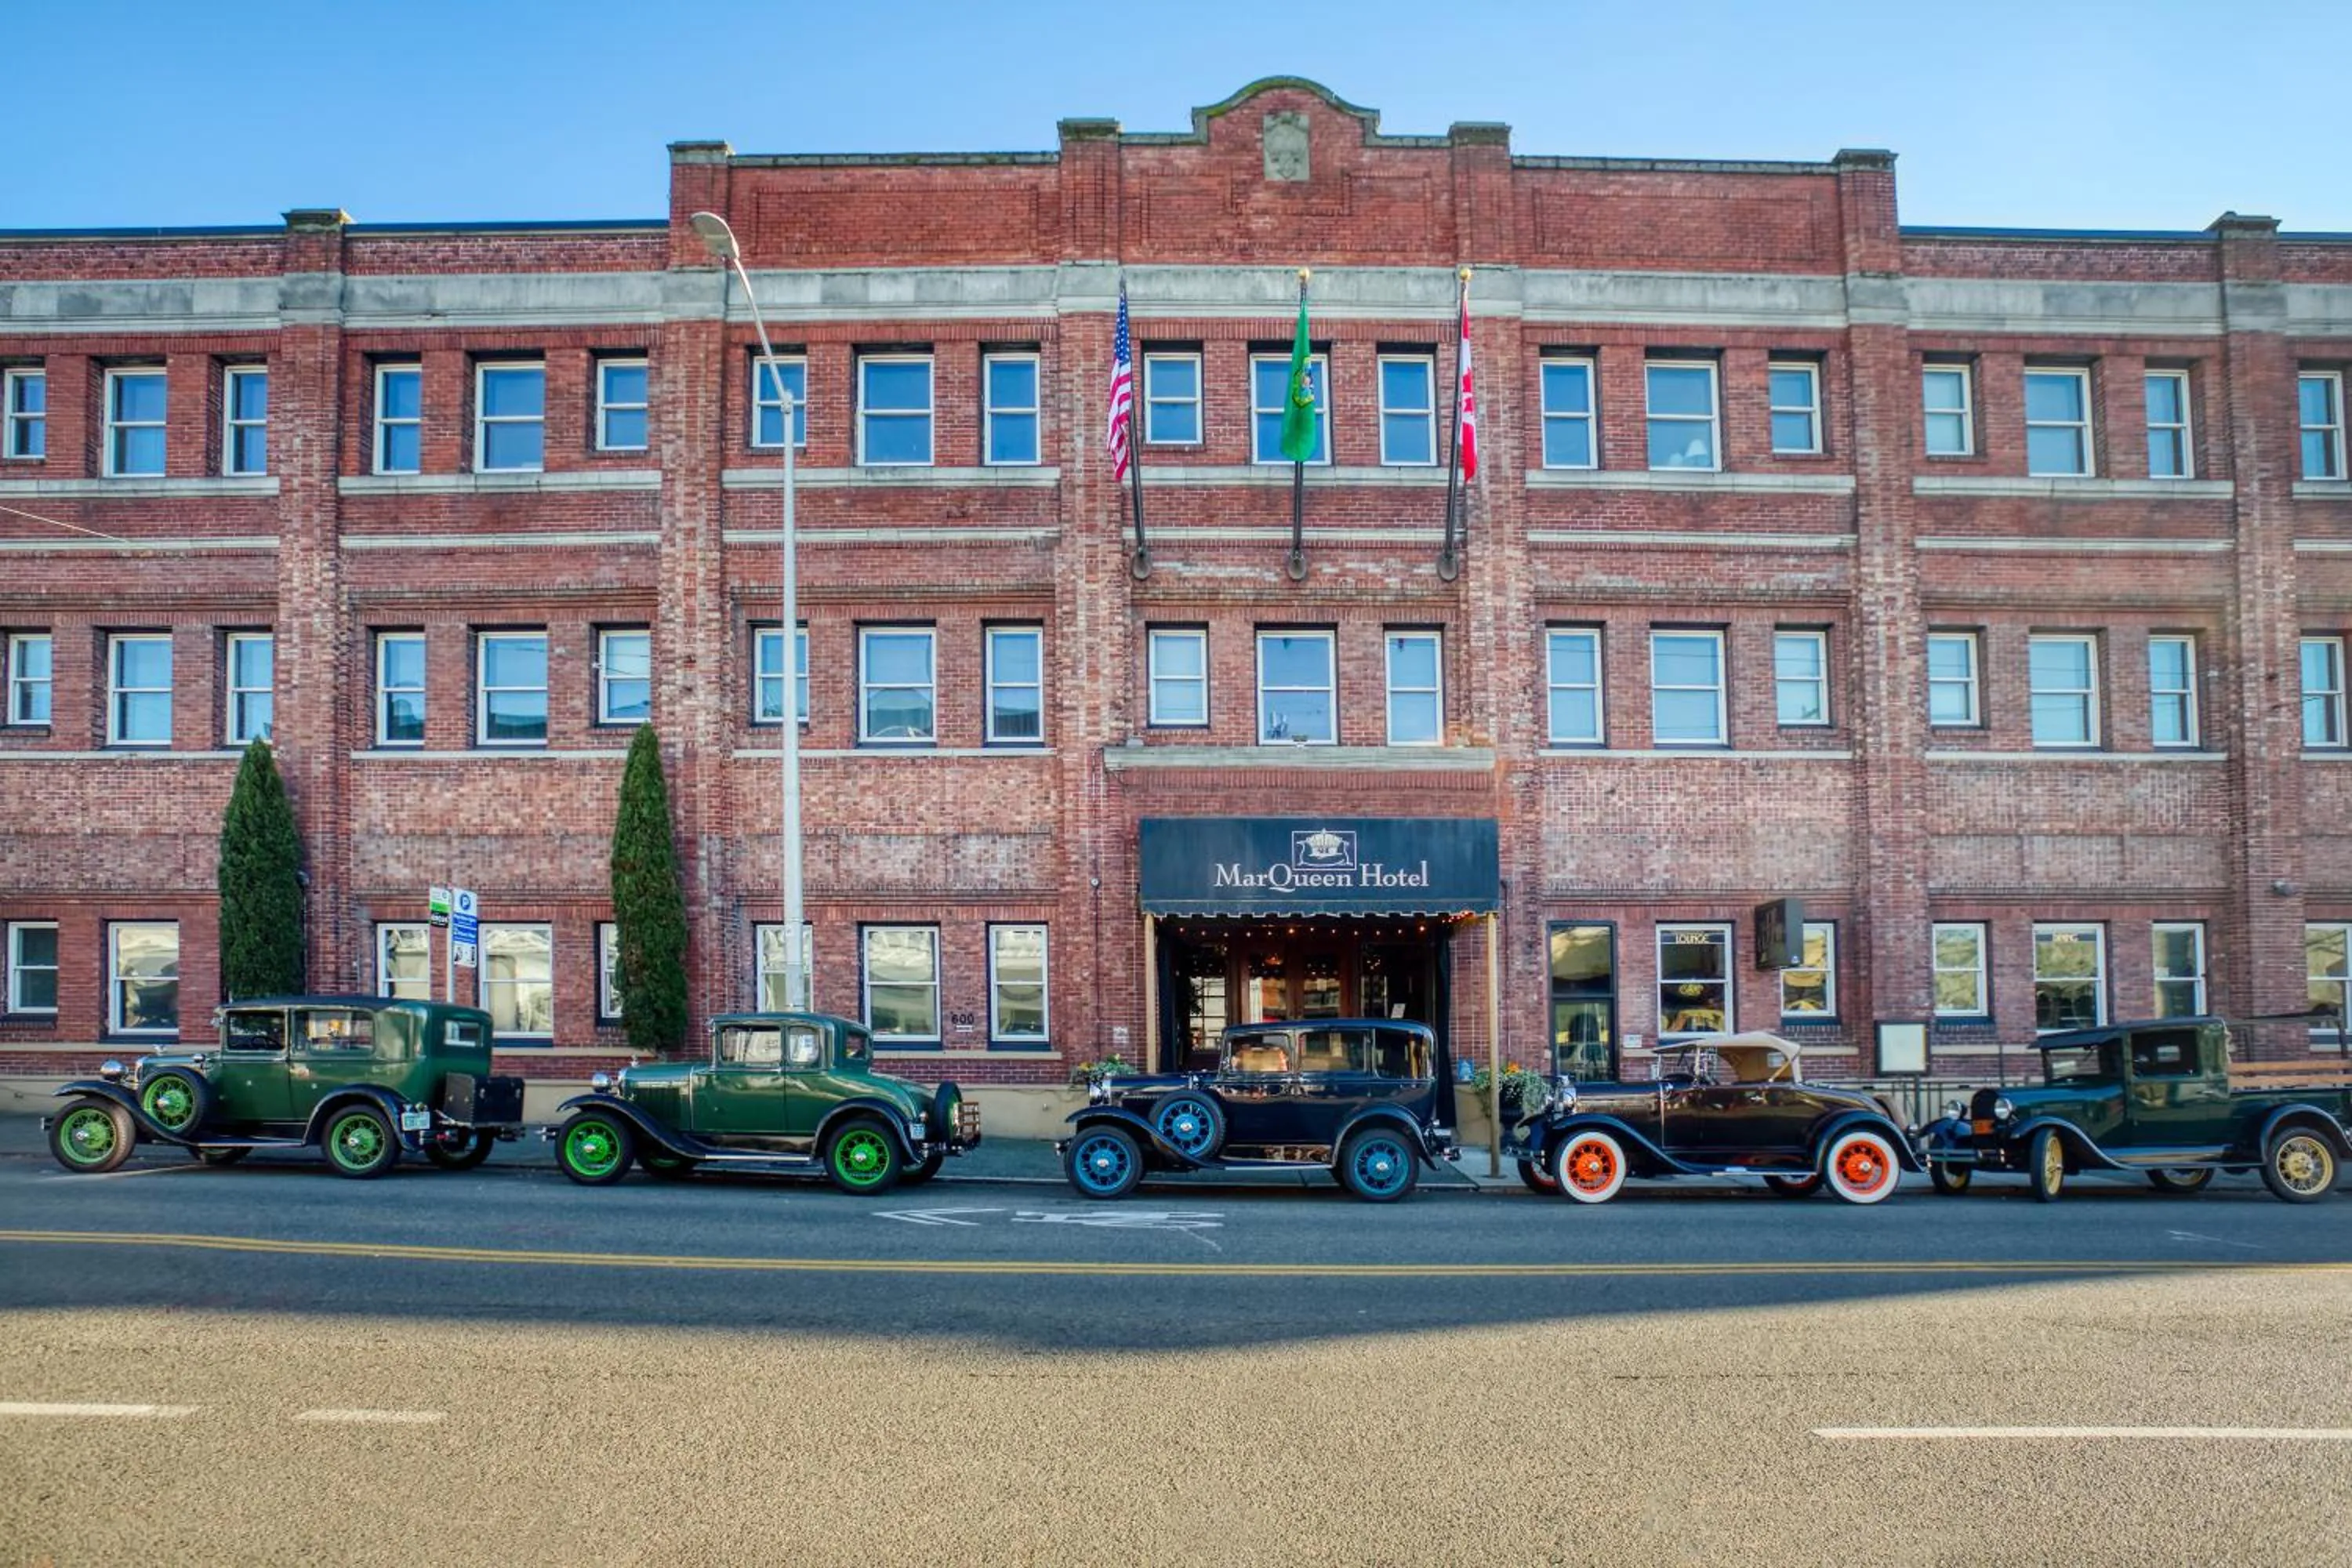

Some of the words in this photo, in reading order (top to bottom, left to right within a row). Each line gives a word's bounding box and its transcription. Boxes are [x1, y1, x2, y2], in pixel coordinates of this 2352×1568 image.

[1214, 862, 1354, 892] MarQueen
[1359, 860, 1430, 887] Hotel
[1675, 932, 1710, 945] LOUNGE
[951, 1013, 975, 1025] 600
